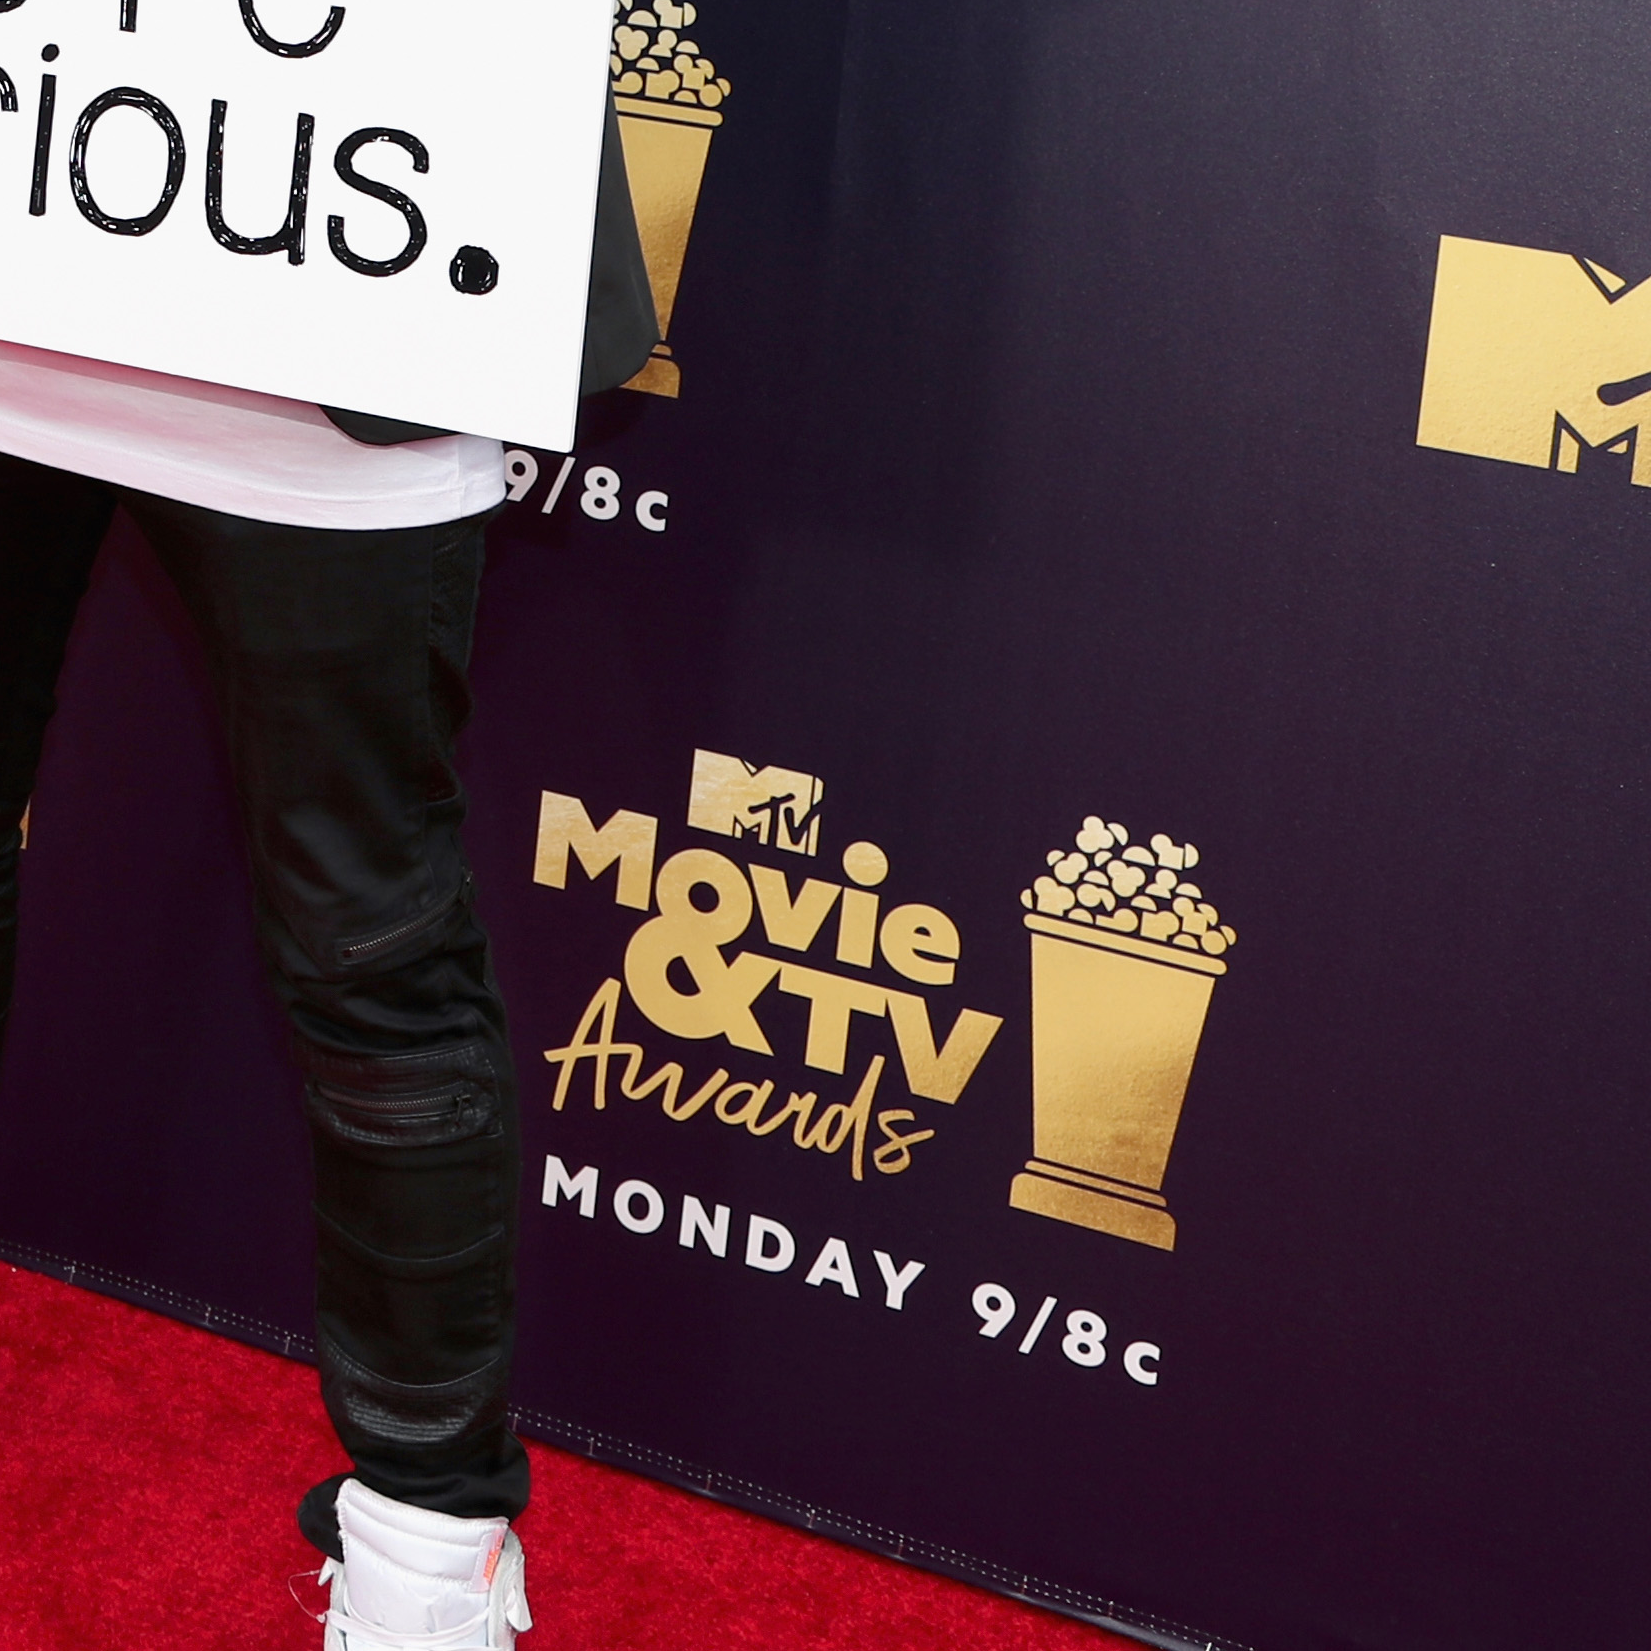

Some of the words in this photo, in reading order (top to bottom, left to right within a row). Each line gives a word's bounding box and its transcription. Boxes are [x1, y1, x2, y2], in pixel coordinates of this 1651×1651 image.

[501, 449, 669, 532] 9/8c
[532, 789, 960, 985] Movie
[687, 747, 823, 857] MTV
[543, 977, 934, 1182] Awards
[541, 1155, 925, 1312] MONDAY
[970, 1281, 1162, 1386] 9/8c
